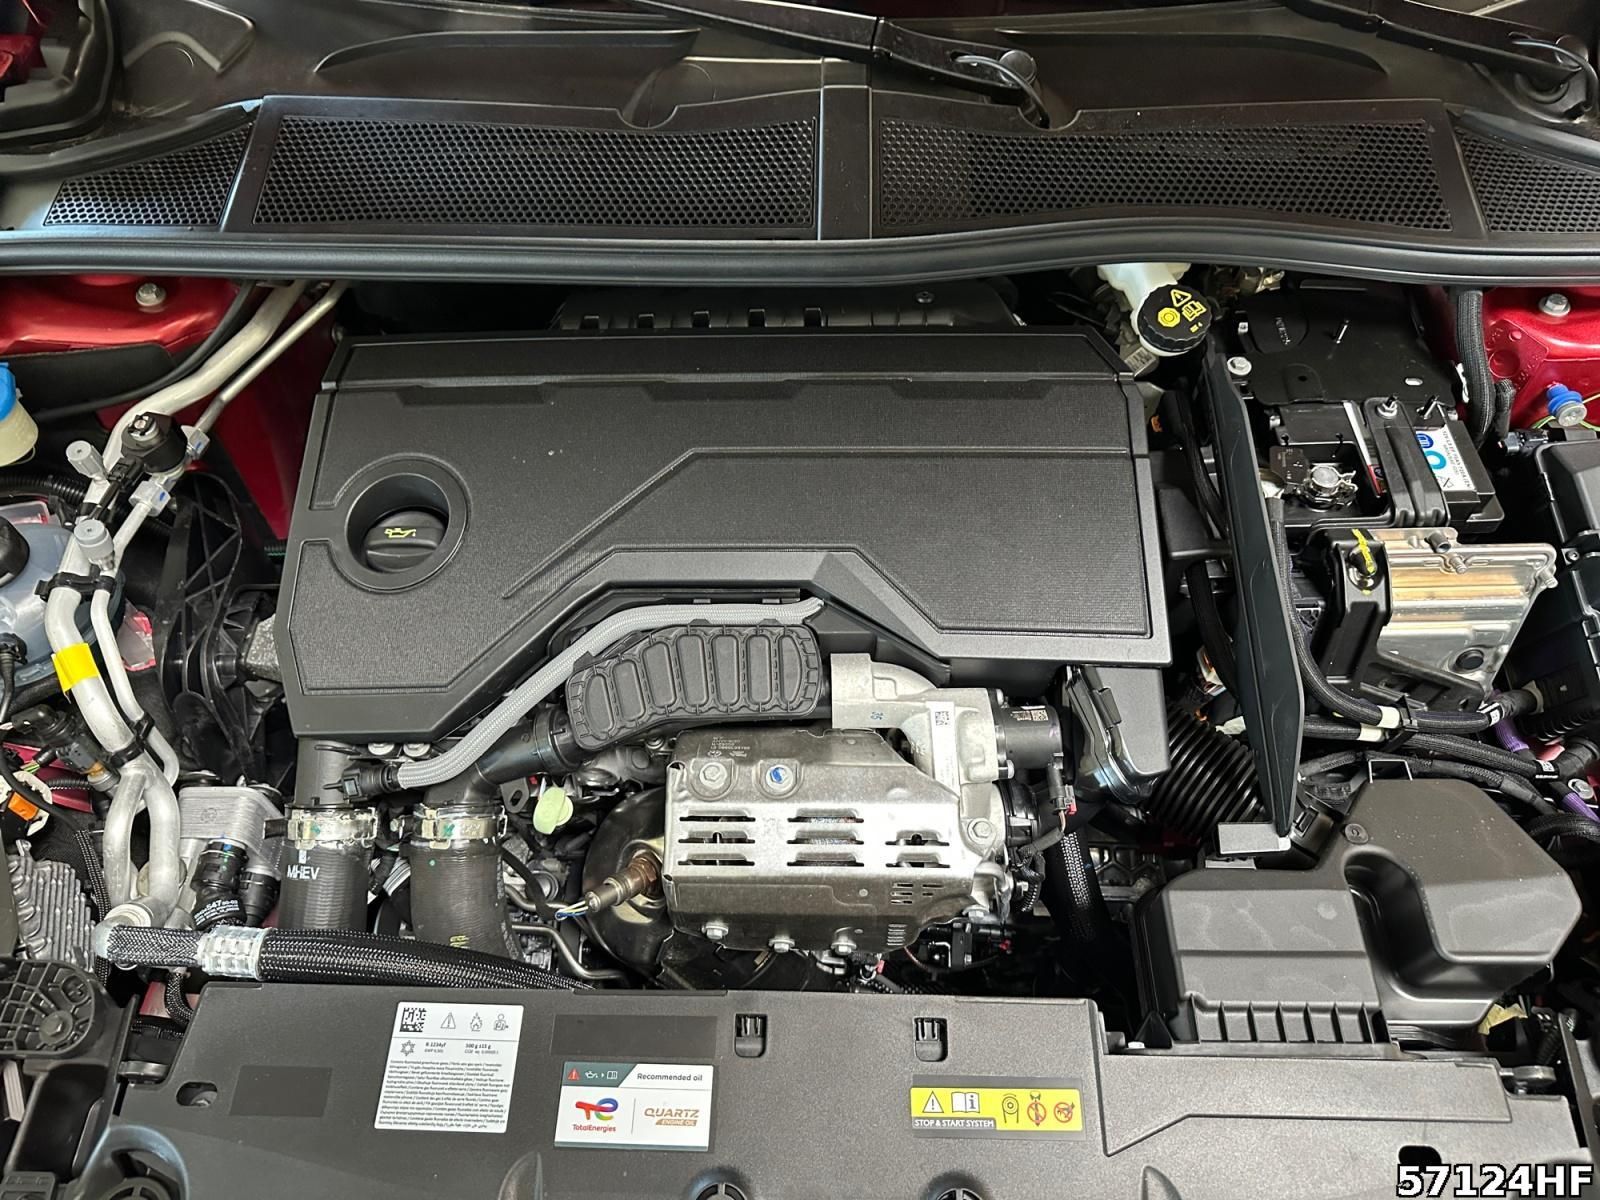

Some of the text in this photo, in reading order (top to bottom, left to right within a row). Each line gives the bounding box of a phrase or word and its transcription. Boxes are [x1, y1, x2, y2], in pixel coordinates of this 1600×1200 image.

[287, 864, 320, 880] MHEV
[637, 1073, 692, 1081] Recommended
[644, 1108, 700, 1118] QUARTZ
[914, 1119, 934, 1128] STOP
[942, 1119, 964, 1128] START
[966, 1120, 994, 1128] SYSTEM
[572, 1124, 616, 1133] TotalEnergies
